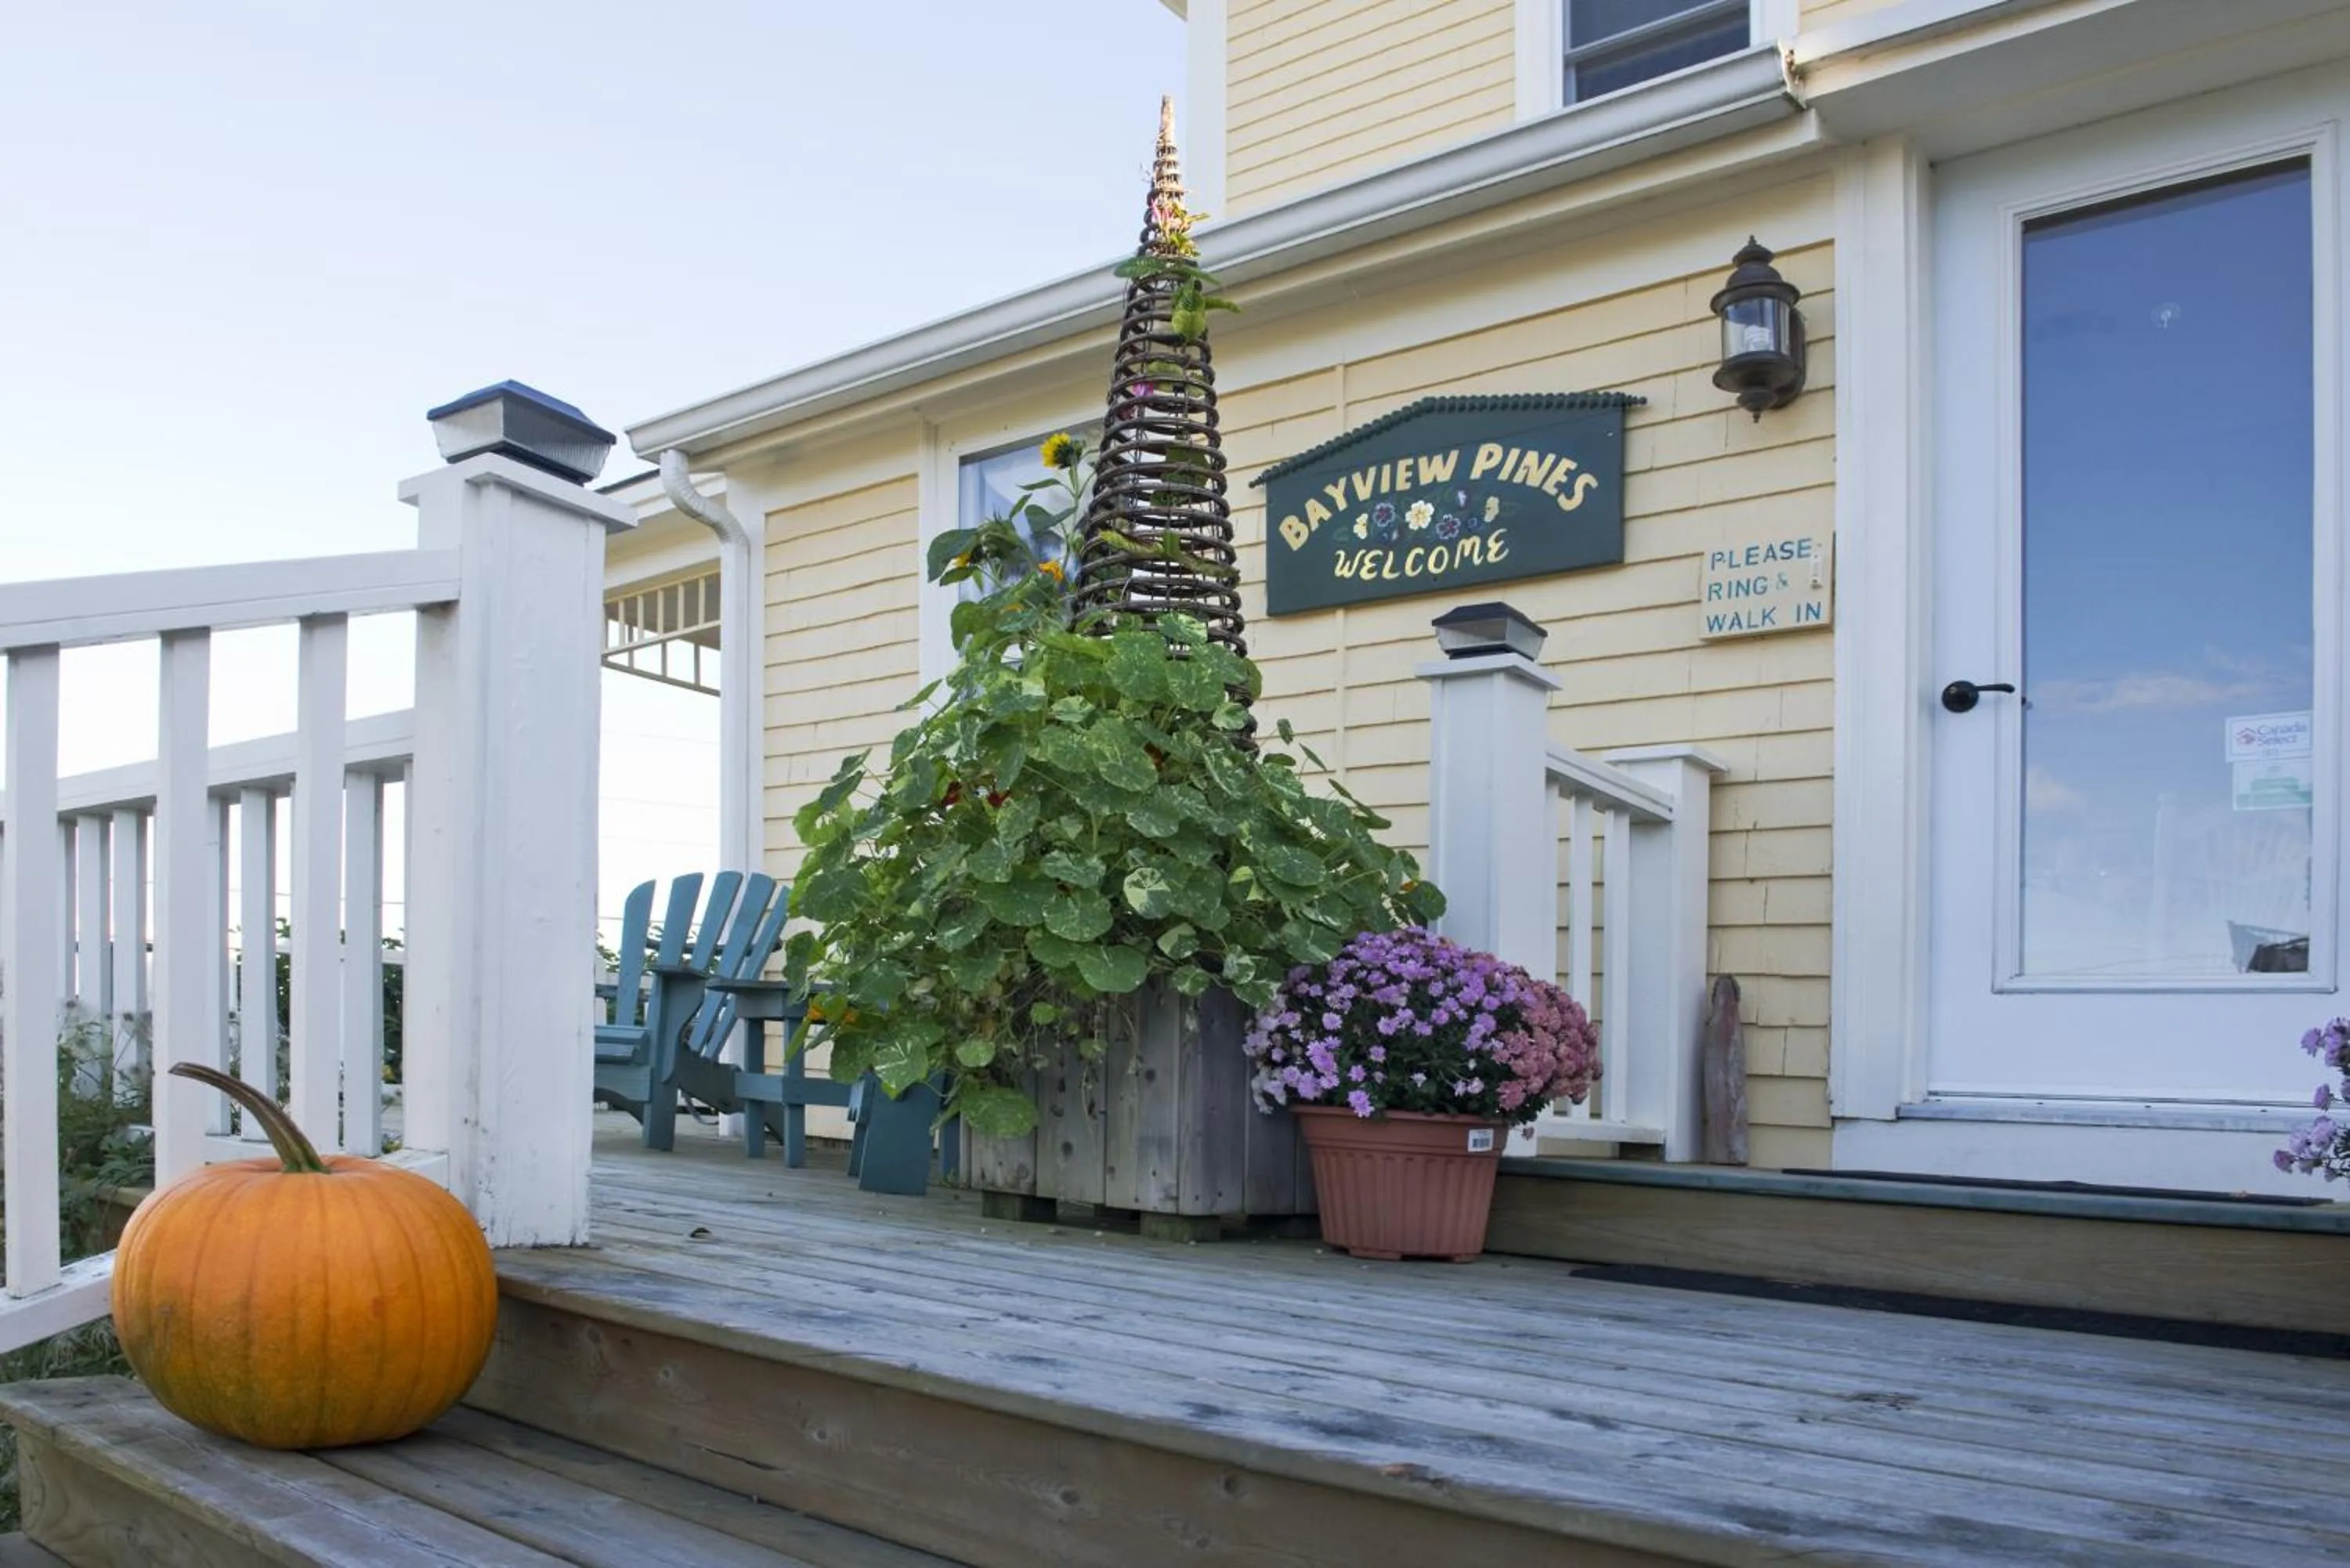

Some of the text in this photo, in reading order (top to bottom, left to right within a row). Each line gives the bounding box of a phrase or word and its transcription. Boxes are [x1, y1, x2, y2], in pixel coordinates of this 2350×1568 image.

[1278, 443, 1599, 551] BAYVIEW PINES
[1334, 529, 1509, 581] WELCOME
[1711, 538, 1812, 570] PLEASE
[1708, 576, 1769, 602] RING
[1706, 602, 1821, 633] WALK IN
